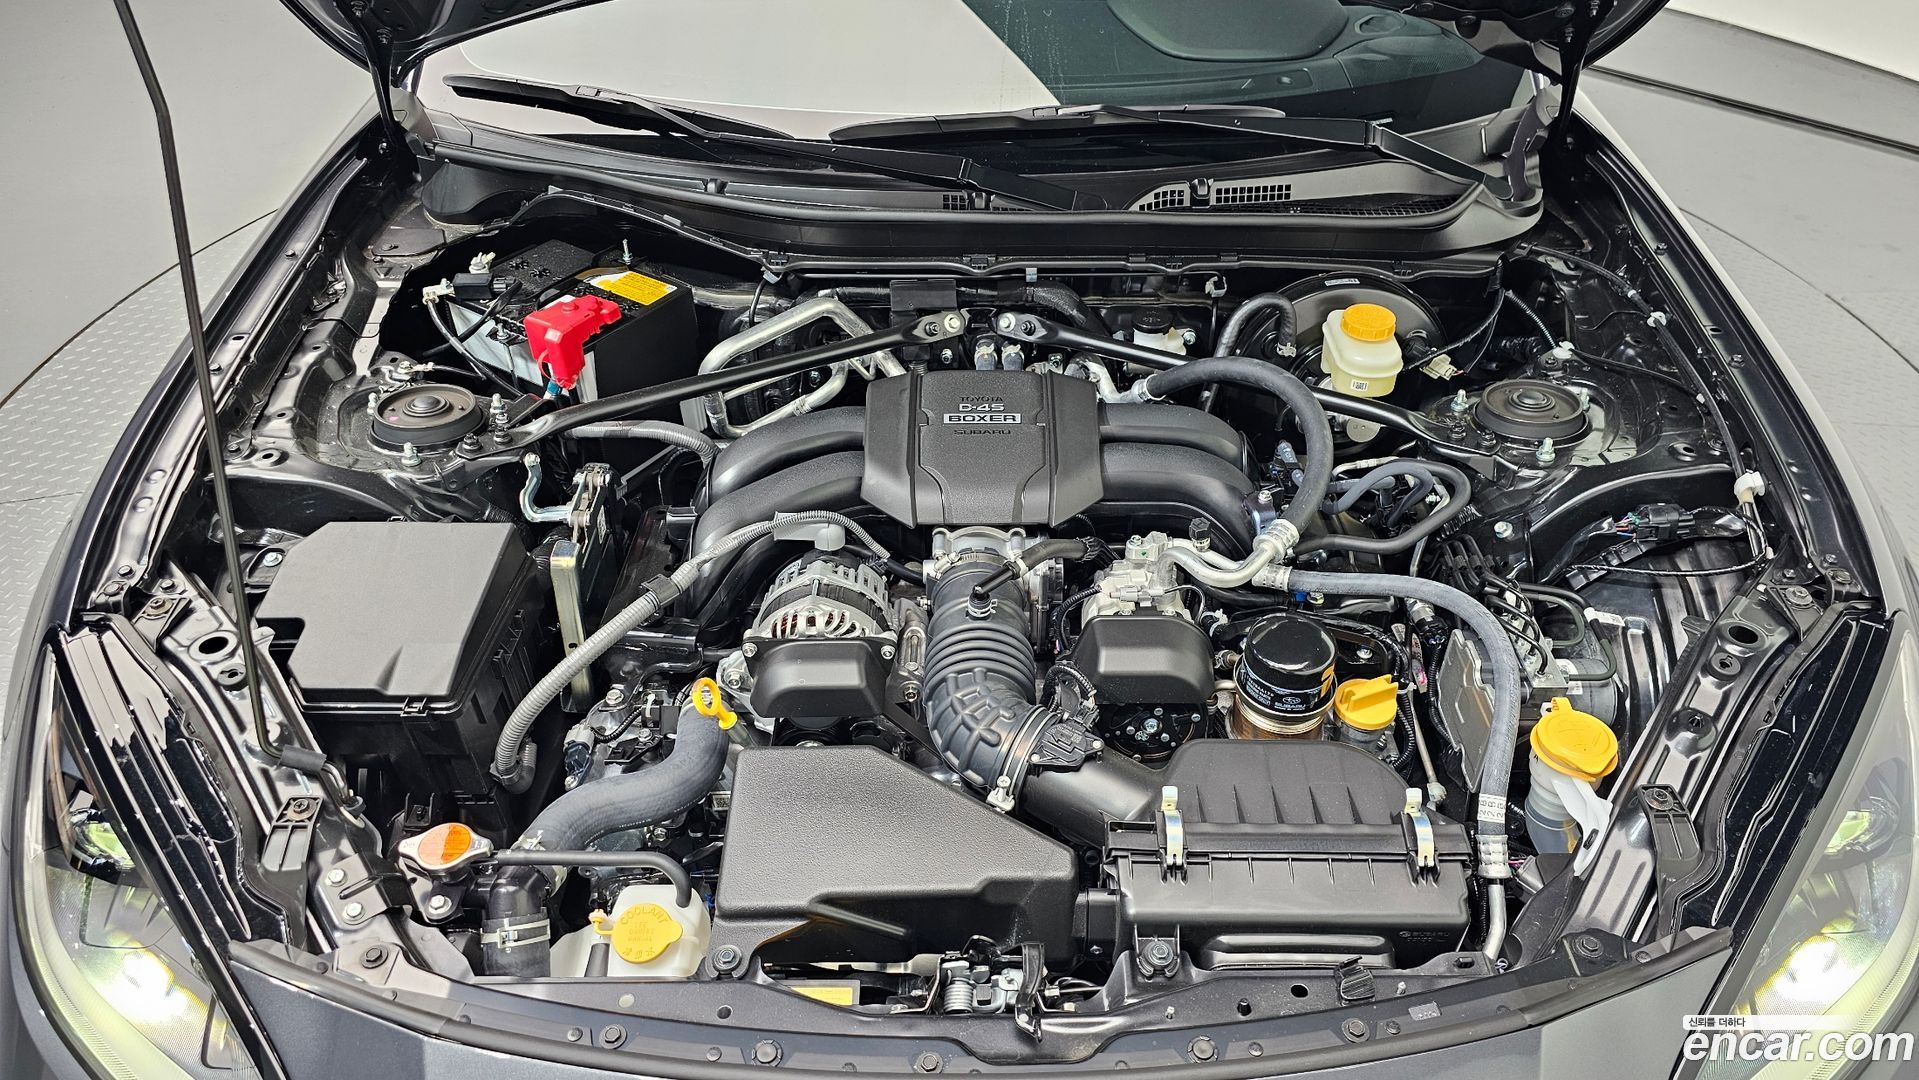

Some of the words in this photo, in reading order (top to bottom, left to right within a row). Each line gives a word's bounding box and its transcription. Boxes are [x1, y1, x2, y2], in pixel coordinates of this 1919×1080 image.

[959, 403, 1005, 412] D-4S
[948, 414, 1017, 422] BOXER
[620, 906, 669, 925] COOLANT
